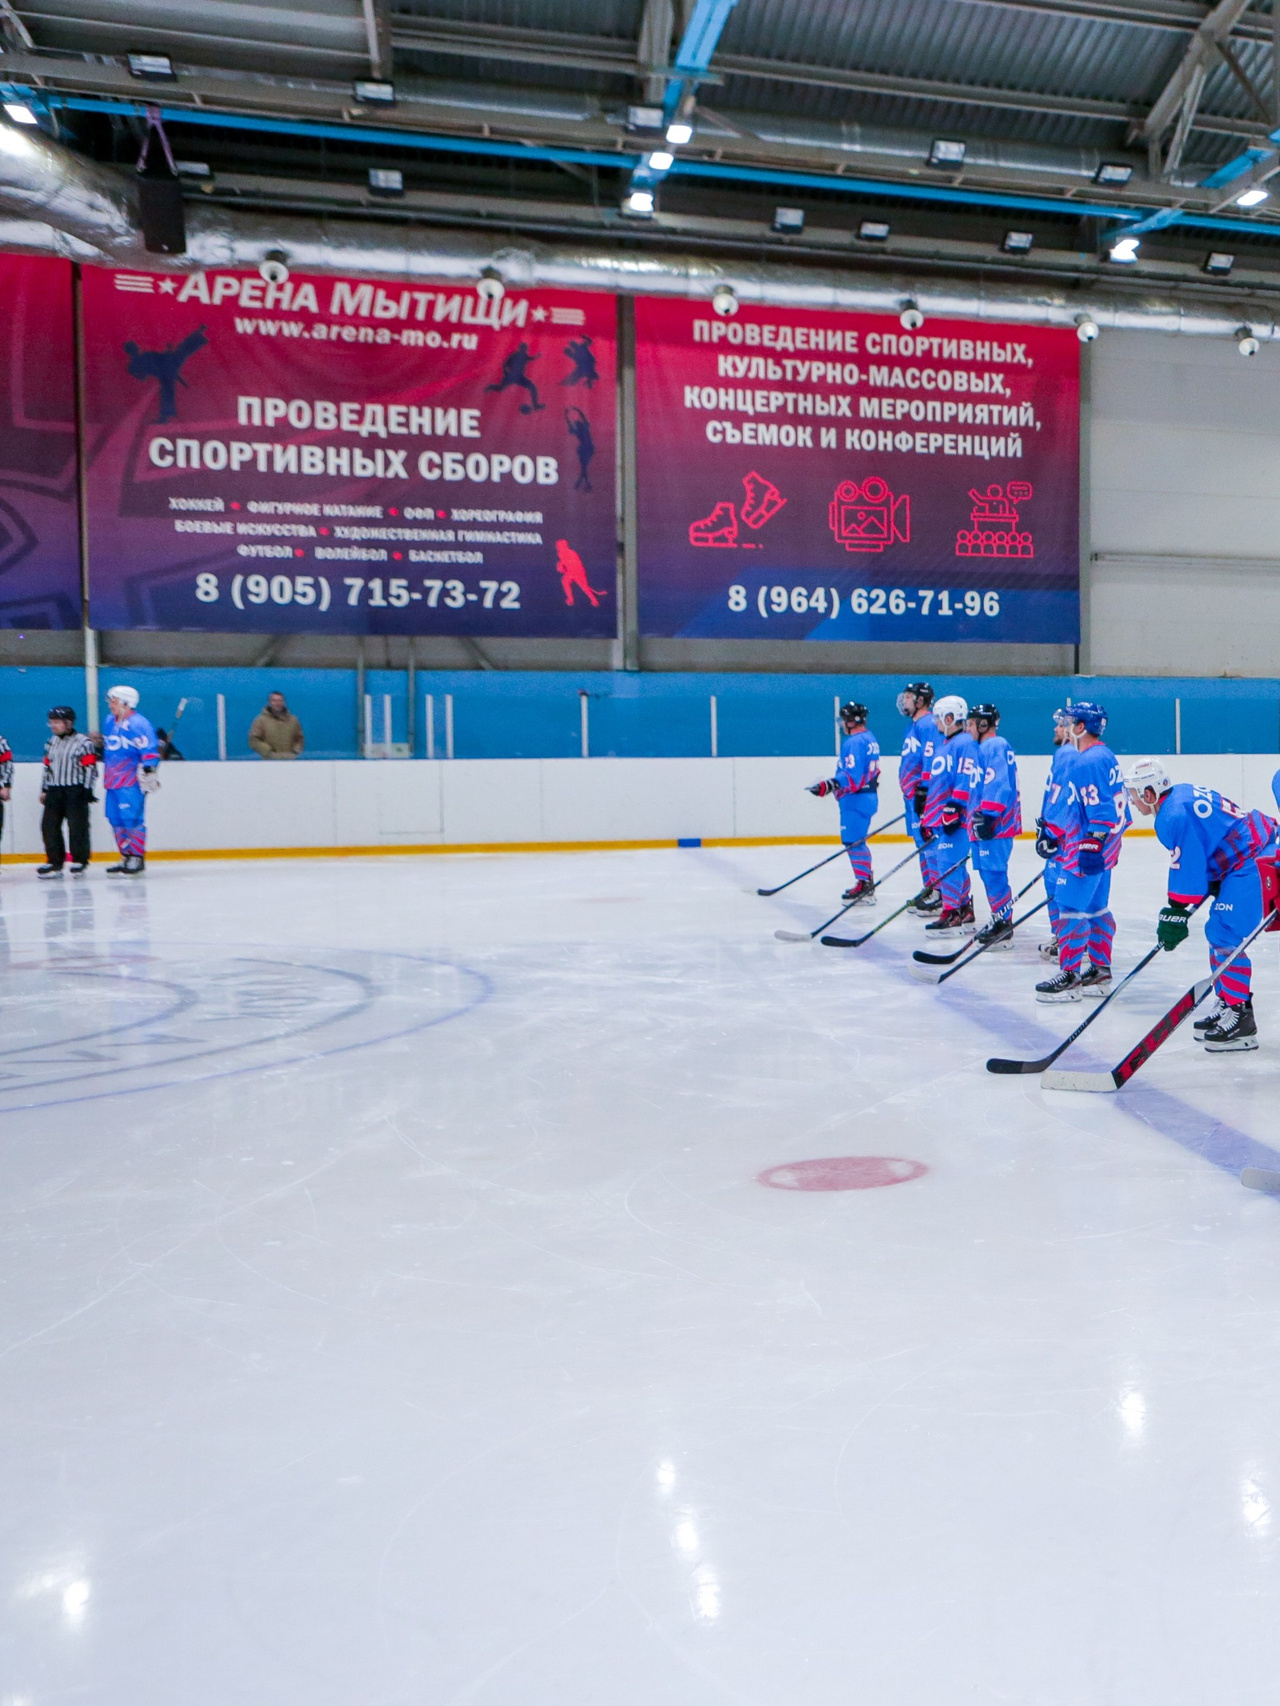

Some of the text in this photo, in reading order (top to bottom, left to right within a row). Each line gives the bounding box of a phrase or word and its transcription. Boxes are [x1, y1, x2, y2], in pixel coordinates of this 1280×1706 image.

[176, 271, 529, 331] АРЕНА МЫТИЩИ
[234, 316, 478, 350] www.arena-mo.ru
[693, 319, 1034, 368] ПРОВЕДЕНИЕ СПОРТИВНЫХ,
[717, 354, 1011, 399] КУЛЬТУРНО-МАССОВЫХ,
[237, 395, 481, 438] ПРОВЕДЕНИЕ
[684, 385, 1042, 431] КОНЦЕРТНЫХ МЕРОПРИЯТИЙ,
[149, 437, 559, 485] СПОРТИВНЫХ СБОРОВ
[705, 420, 1023, 461] СЪЕМОК И КОНФЕРЕНЦИЙ
[195, 572, 521, 612] 8 (905) 715-73-72
[728, 585, 1000, 619] 8 (964) 626-71-96
[1214, 903, 1233, 911] ZON
